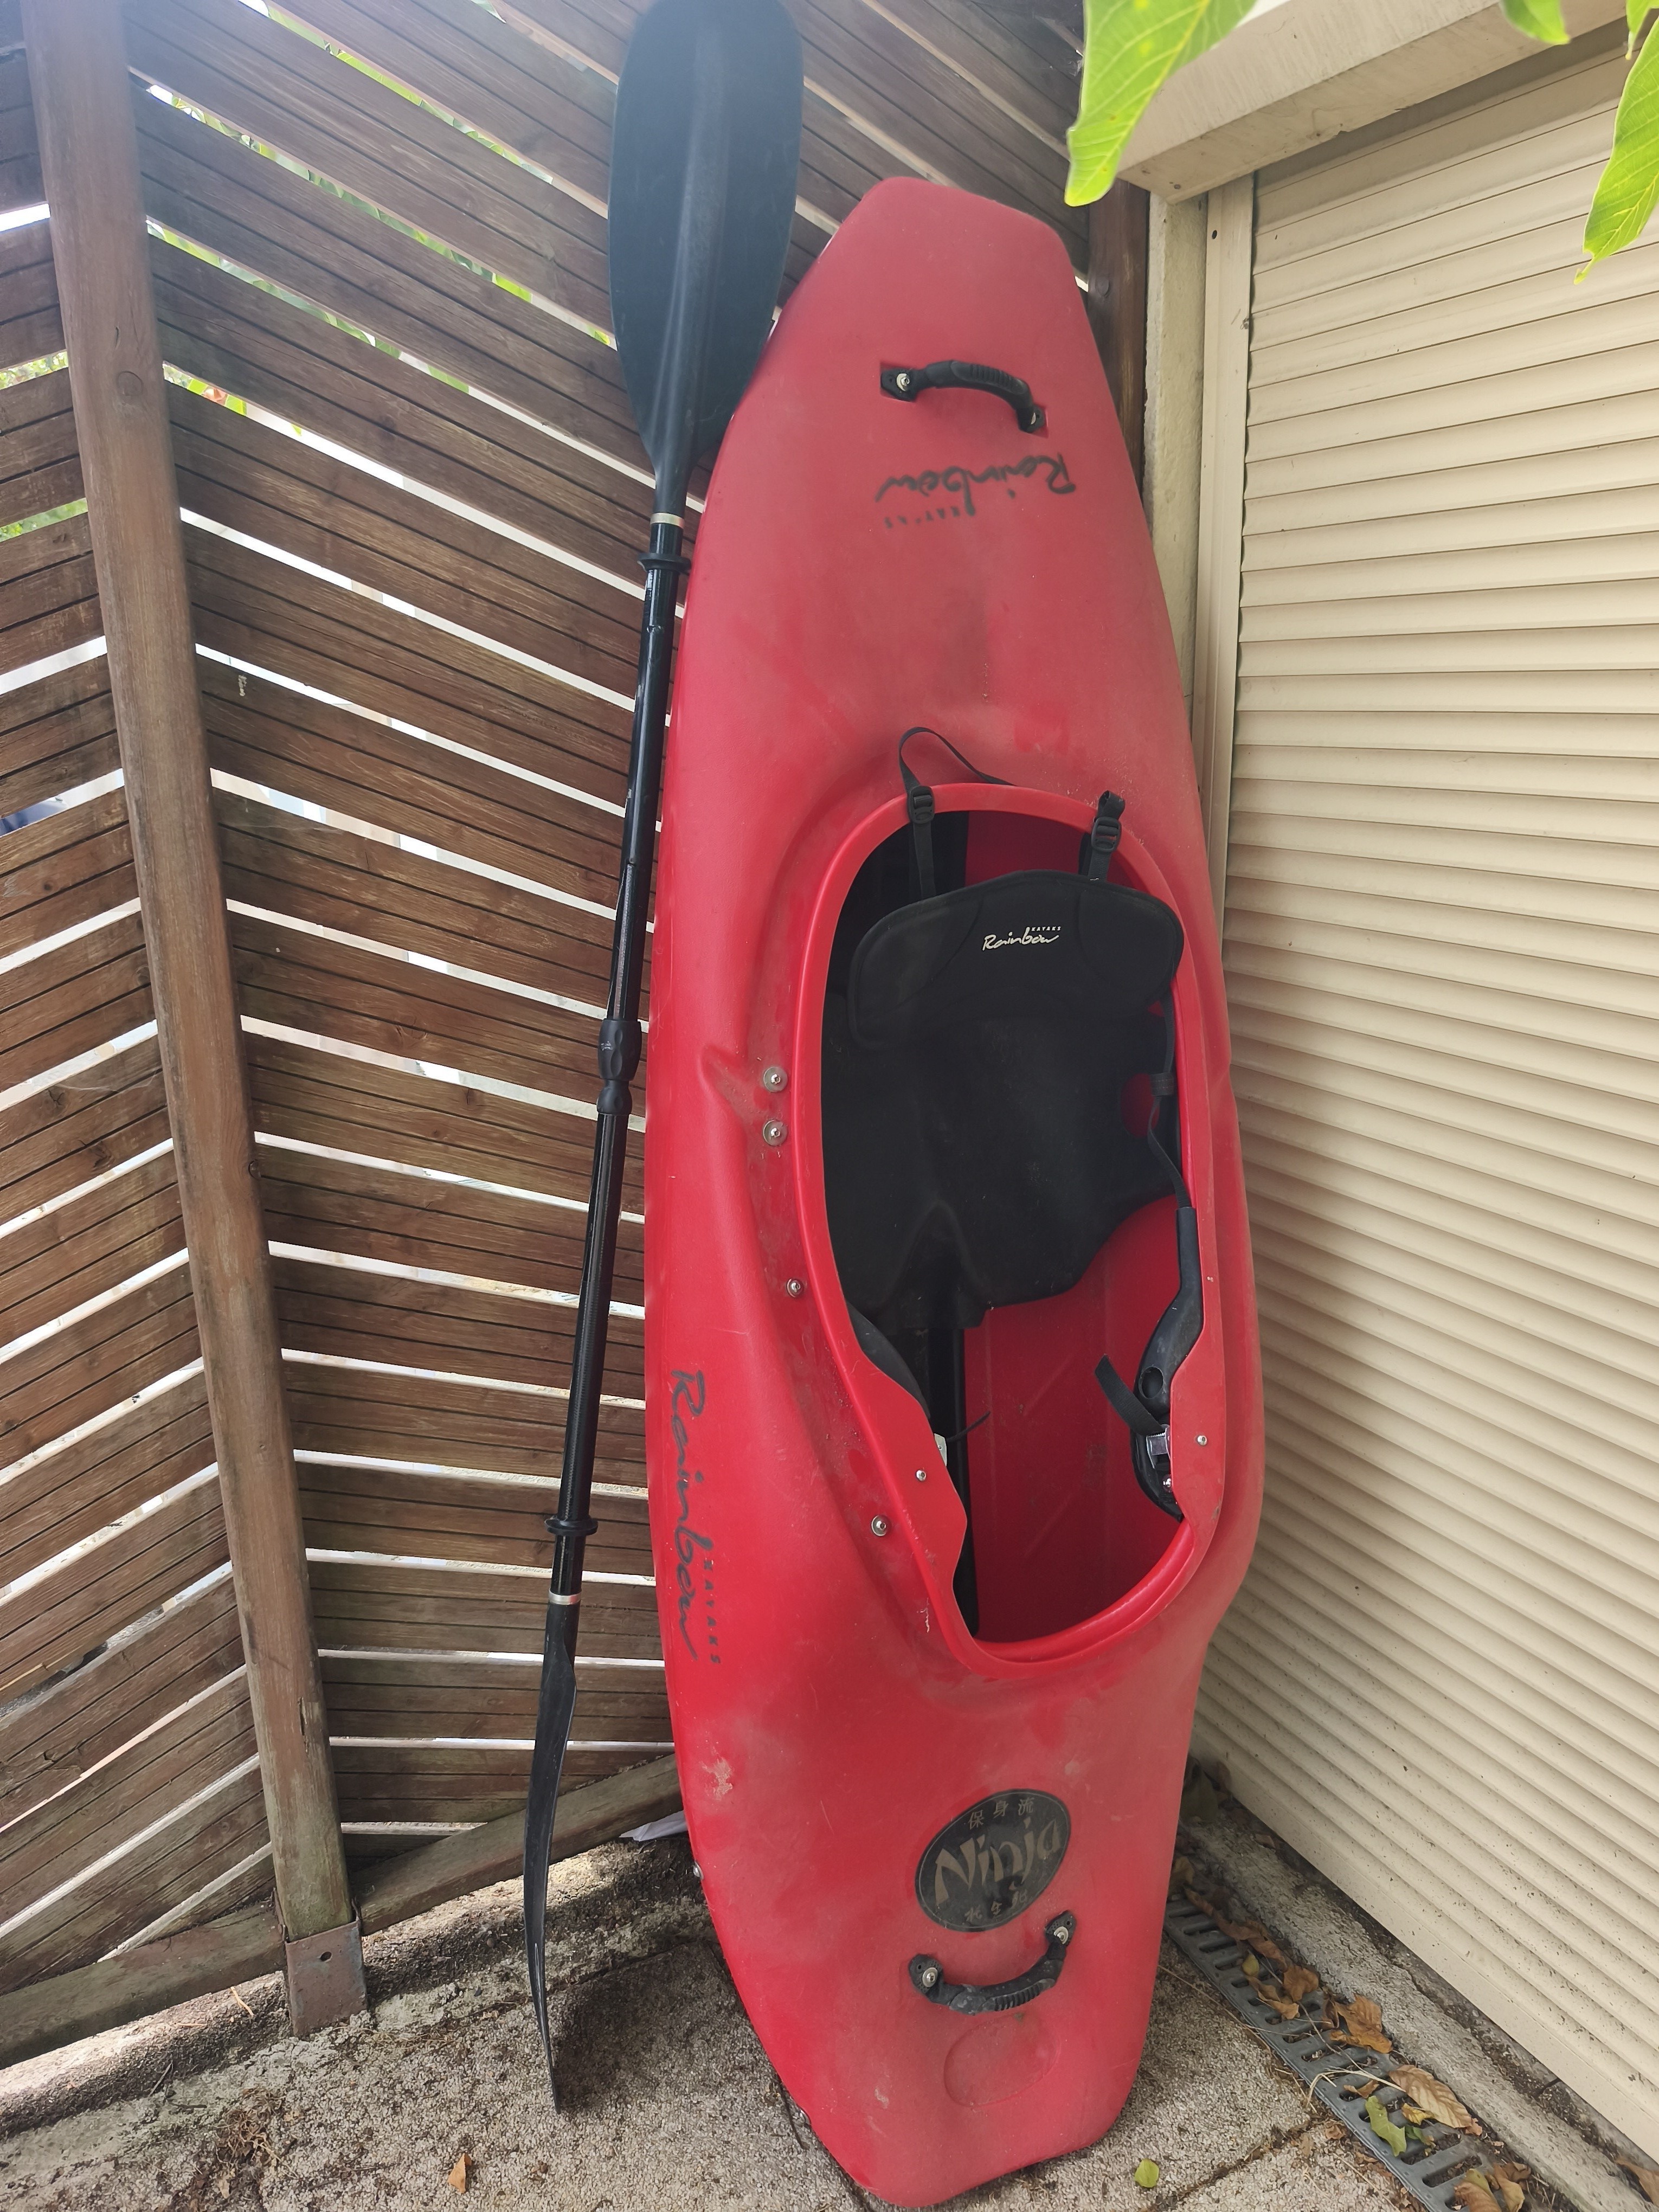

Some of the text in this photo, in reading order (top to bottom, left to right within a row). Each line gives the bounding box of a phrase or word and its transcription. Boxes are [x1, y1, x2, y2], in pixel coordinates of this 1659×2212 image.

[874, 452, 1076, 516] Rainbow
[982, 927, 1059, 951] Rainbow
[671, 1369, 714, 1660] Rainbow
[704, 1559, 721, 1664] KAYAKS
[935, 1818, 1061, 1907] Ninja
